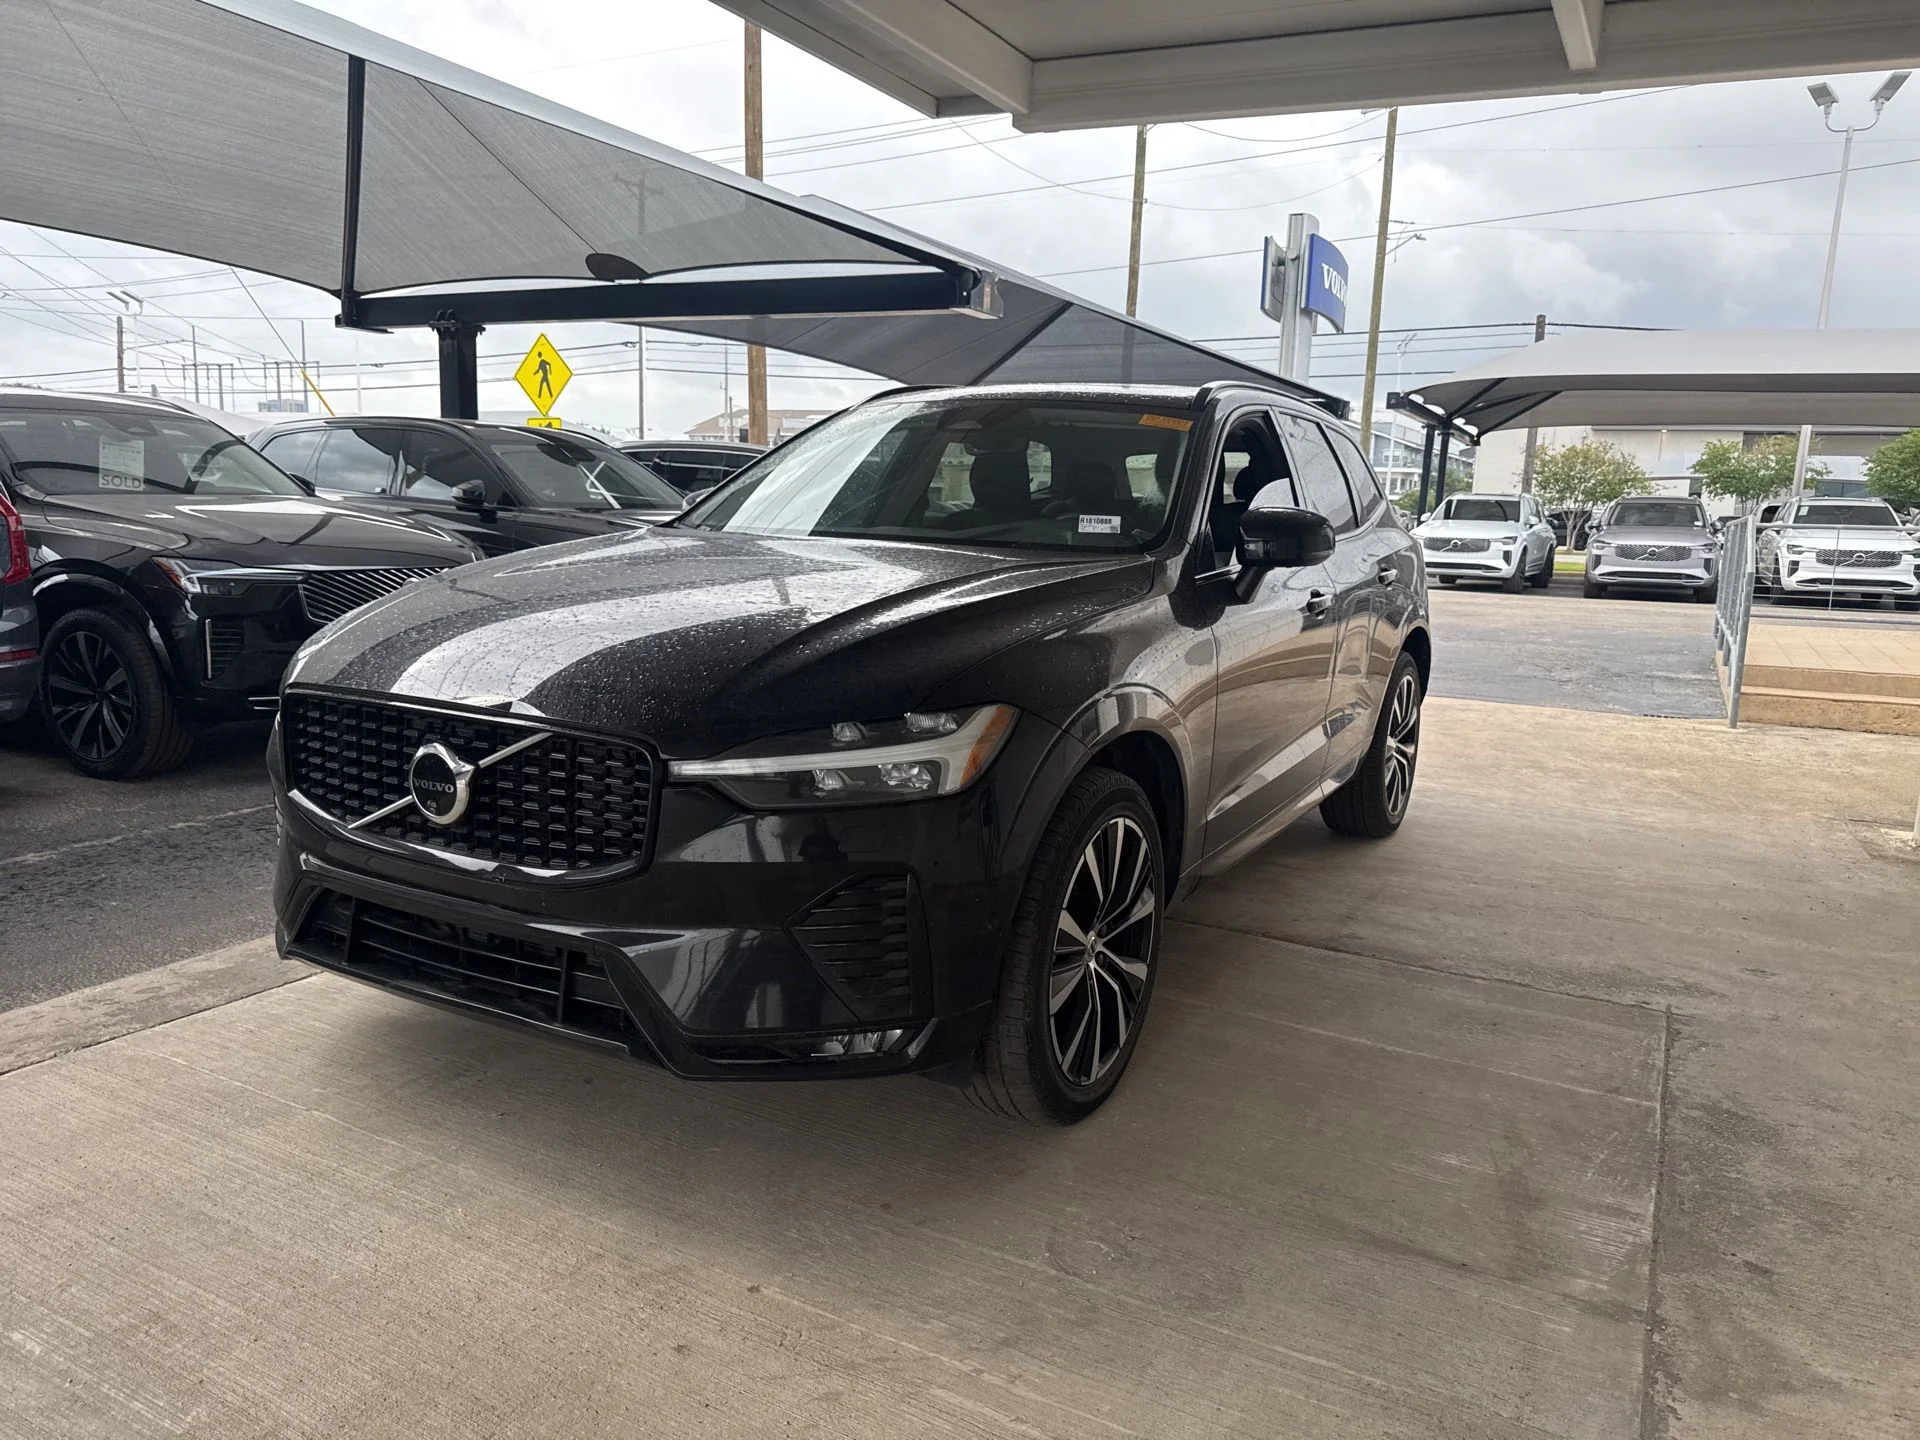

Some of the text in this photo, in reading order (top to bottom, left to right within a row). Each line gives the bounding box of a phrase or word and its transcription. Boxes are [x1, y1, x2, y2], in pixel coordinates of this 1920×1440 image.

[1321, 262, 1347, 307] VOLV
[101, 474, 142, 489] SOLD
[413, 777, 455, 793] VOLVO
